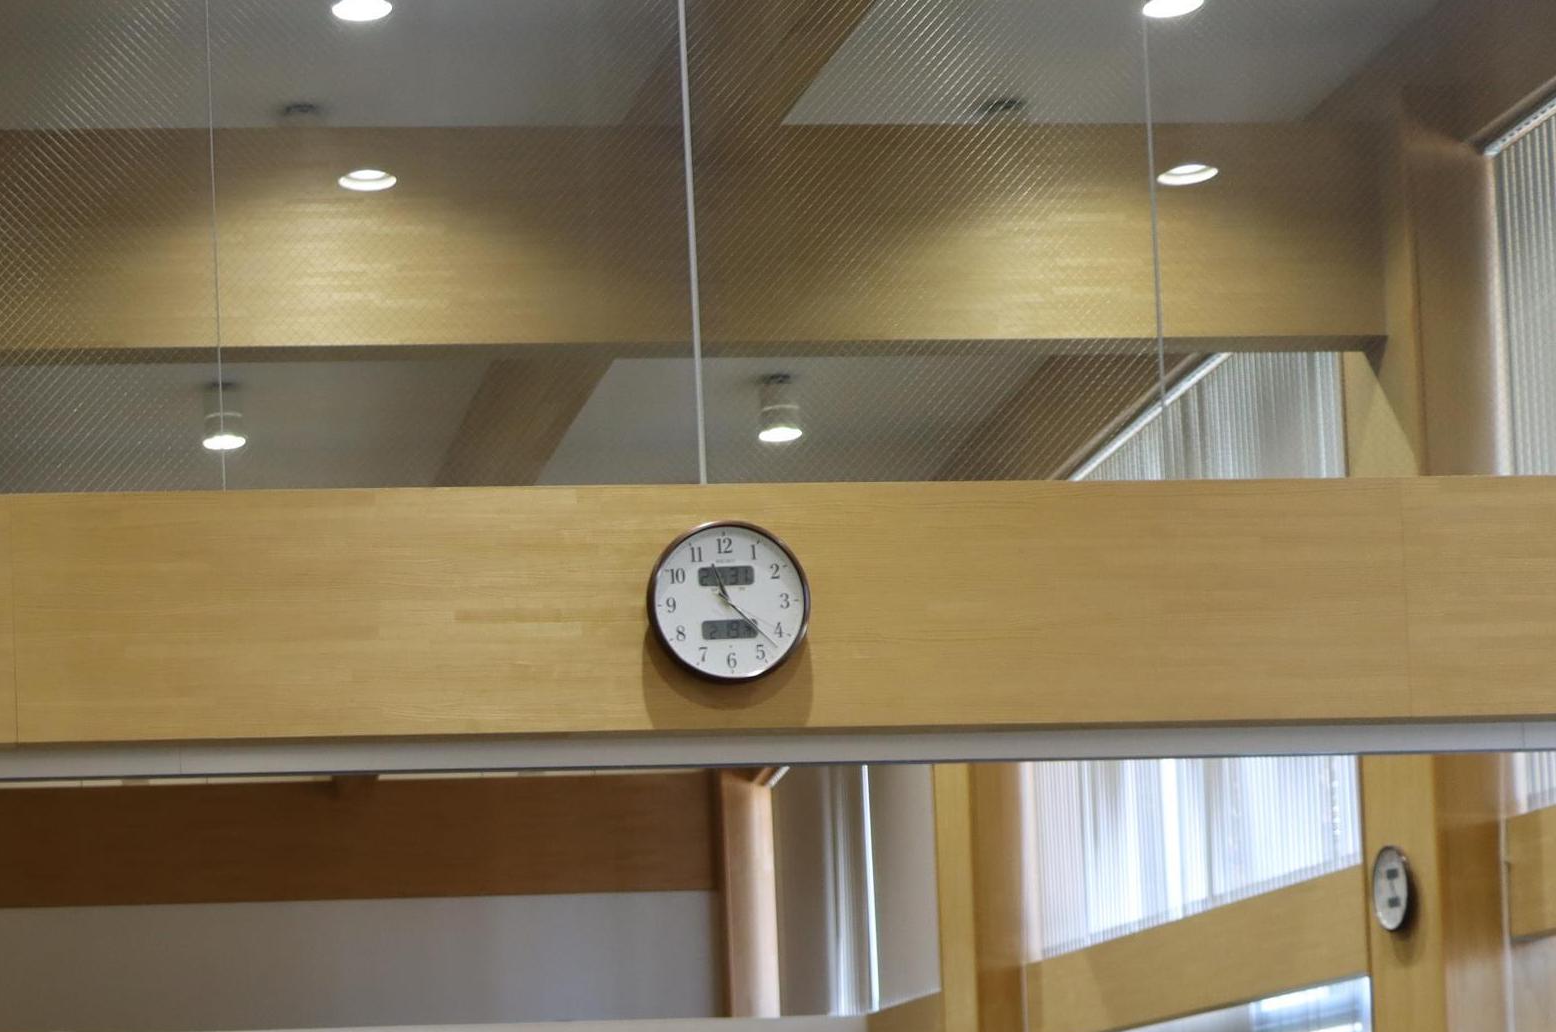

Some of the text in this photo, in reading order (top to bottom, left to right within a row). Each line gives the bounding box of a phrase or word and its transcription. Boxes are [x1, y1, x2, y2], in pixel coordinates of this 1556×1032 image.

[716, 537, 733, 554] 12
[750, 544, 757, 561] 1
[690, 546, 703, 563] 11
[669, 568, 686, 585] 10
[770, 563, 781, 580] 2
[666, 597, 676, 613] 9
[779, 593, 790, 609] 3
[676, 625, 686, 641] 8
[774, 622, 783, 638] 4
[698, 647, 708, 663] 7
[755, 644, 766, 660] 5
[727, 652, 737, 669] 6
